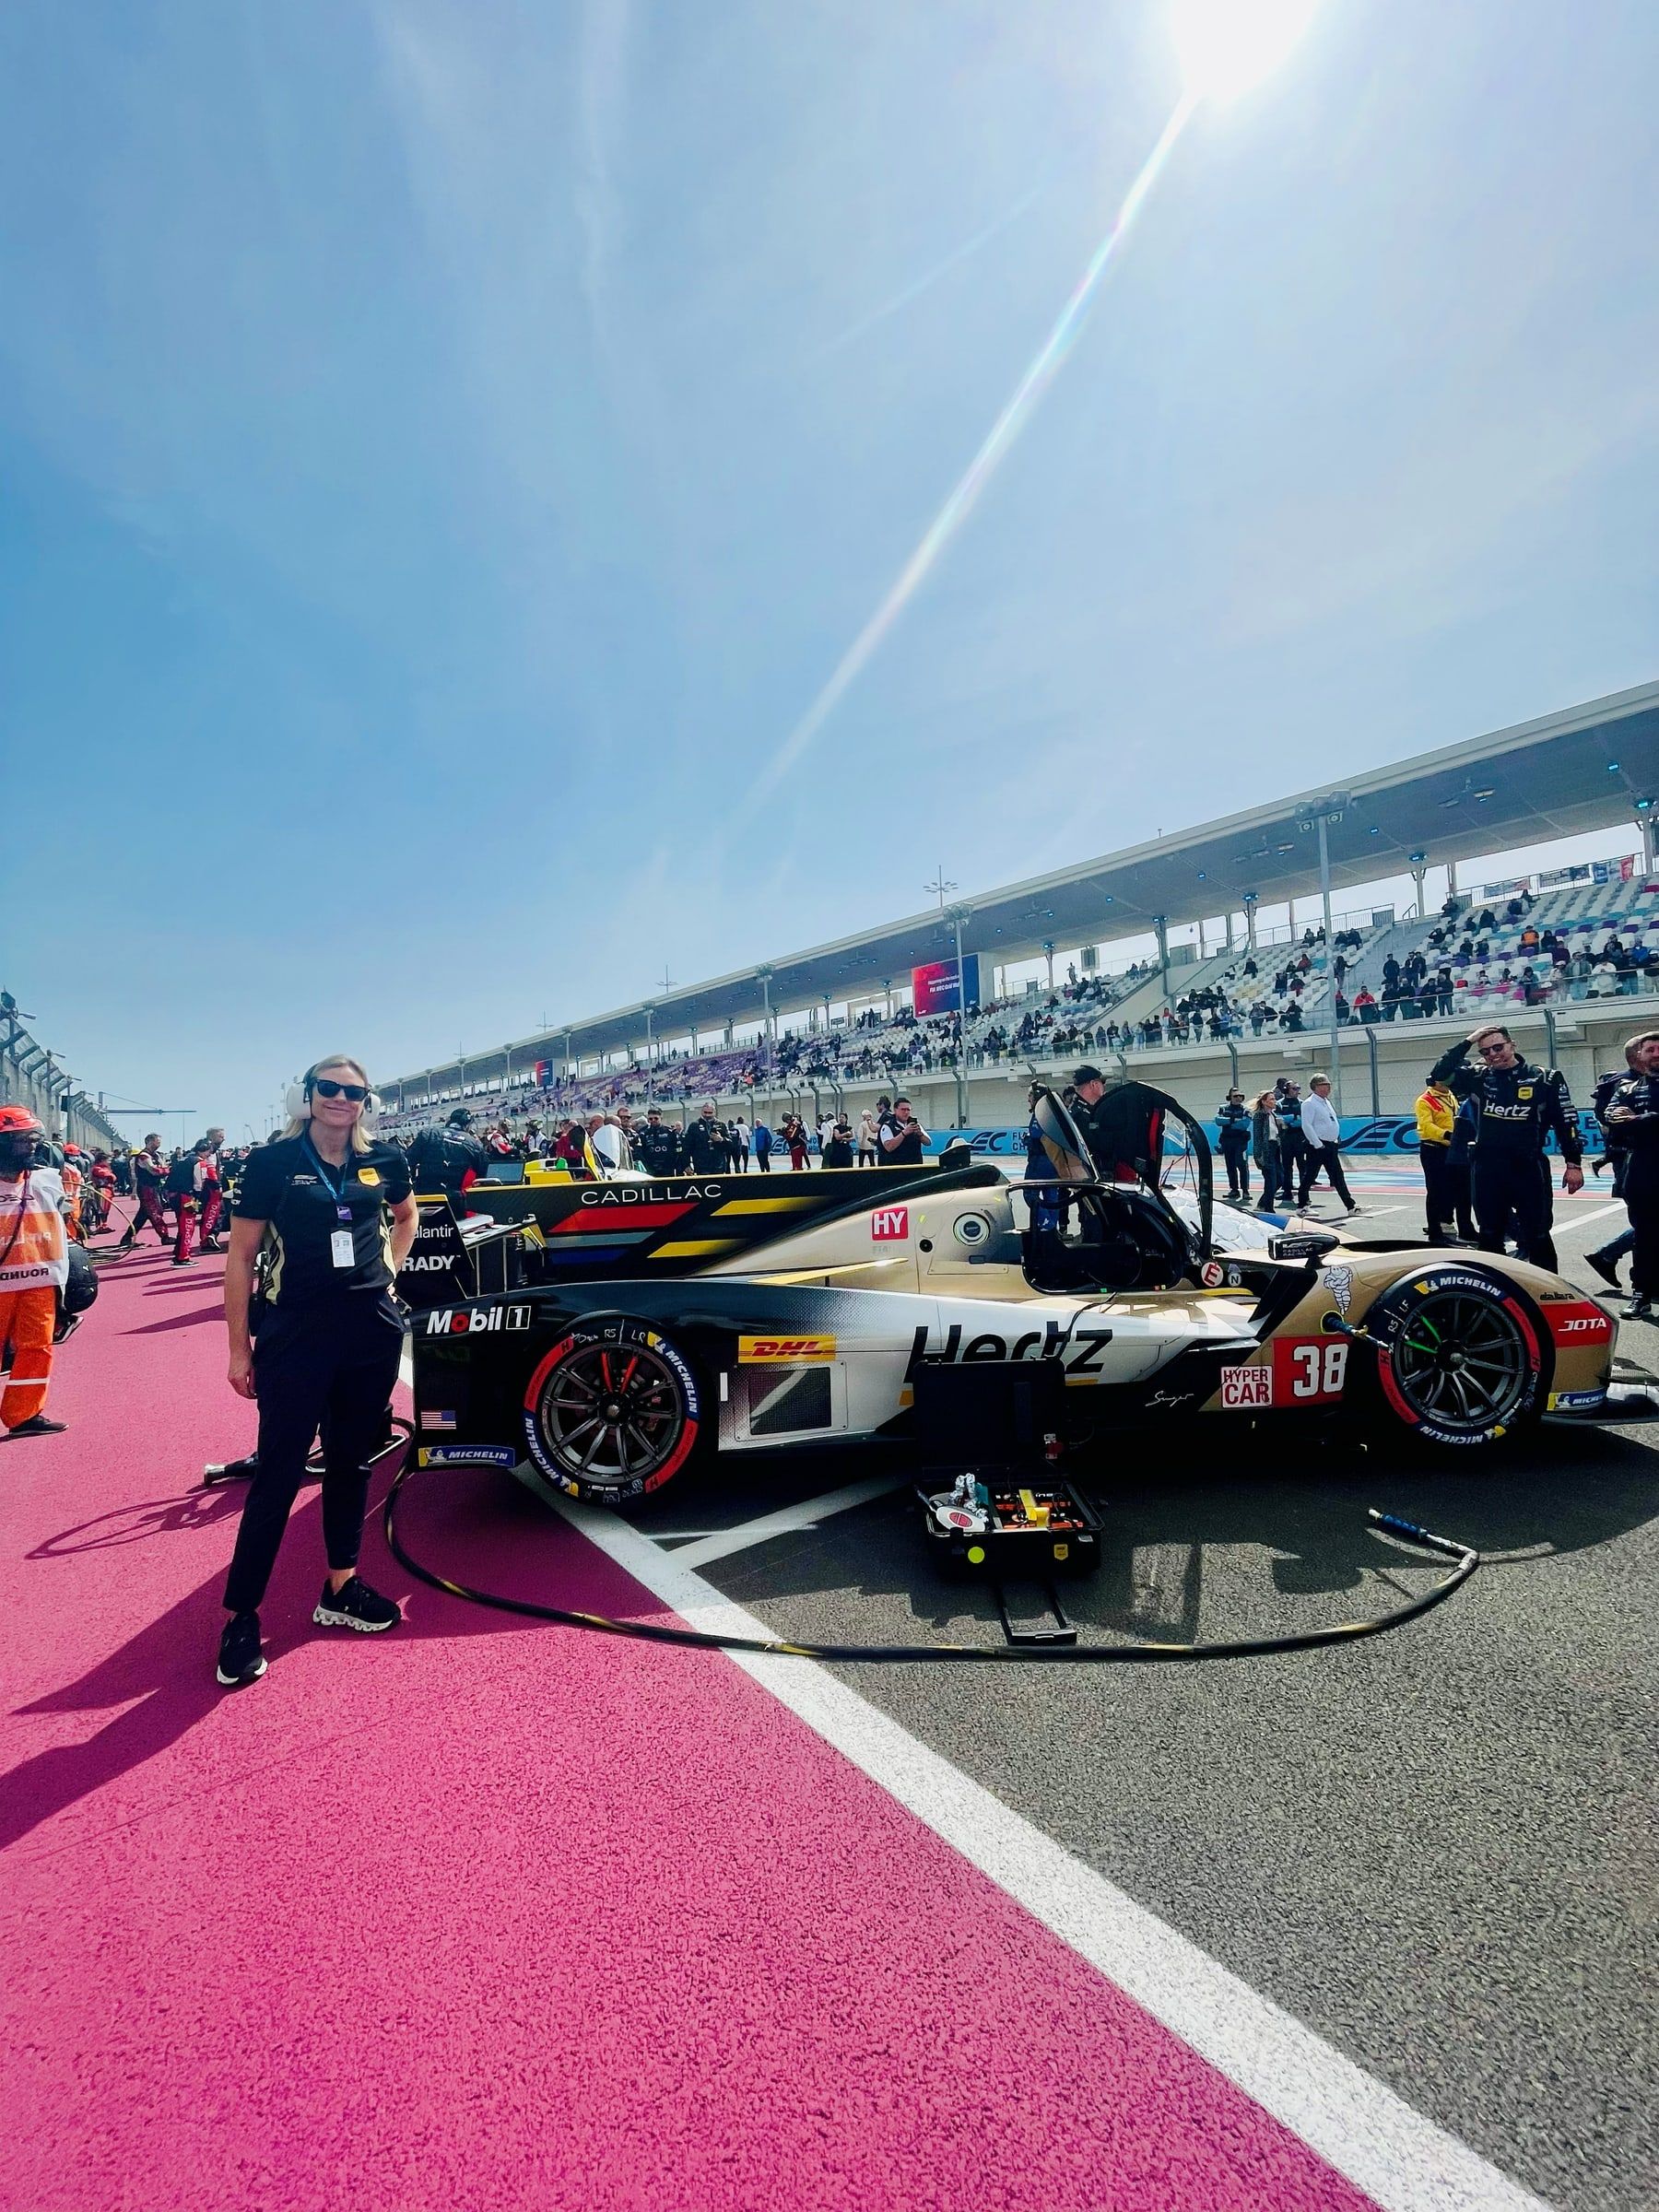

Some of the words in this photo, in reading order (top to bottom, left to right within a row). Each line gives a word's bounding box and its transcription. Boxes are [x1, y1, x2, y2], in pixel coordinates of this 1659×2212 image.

[1484, 1100, 1532, 1117] Hertz
[581, 1184, 722, 1205] CADILLAC
[206, 1205, 218, 1230] DENSO
[873, 1211, 906, 1235] HY
[414, 1223, 454, 1239] alantir
[401, 1254, 454, 1272] RADY
[1205, 1264, 1220, 1286] E
[1231, 1276, 1239, 1284] N
[1440, 1277, 1501, 1297] MICHELIN
[426, 1306, 503, 1335] Mobil
[1558, 1317, 1607, 1332] JOTA
[752, 1341, 823, 1357] DHL
[1224, 1370, 1268, 1383] HYPER
[1293, 1343, 1349, 1397] 38
[665, 1349, 698, 1414] MICHELIN
[1225, 1382, 1270, 1405] CAR
[1419, 1426, 1484, 1444] MICHELIN
[448, 1451, 509, 1461] MICHELIN
[524, 1417, 560, 1480] MICHELIN
